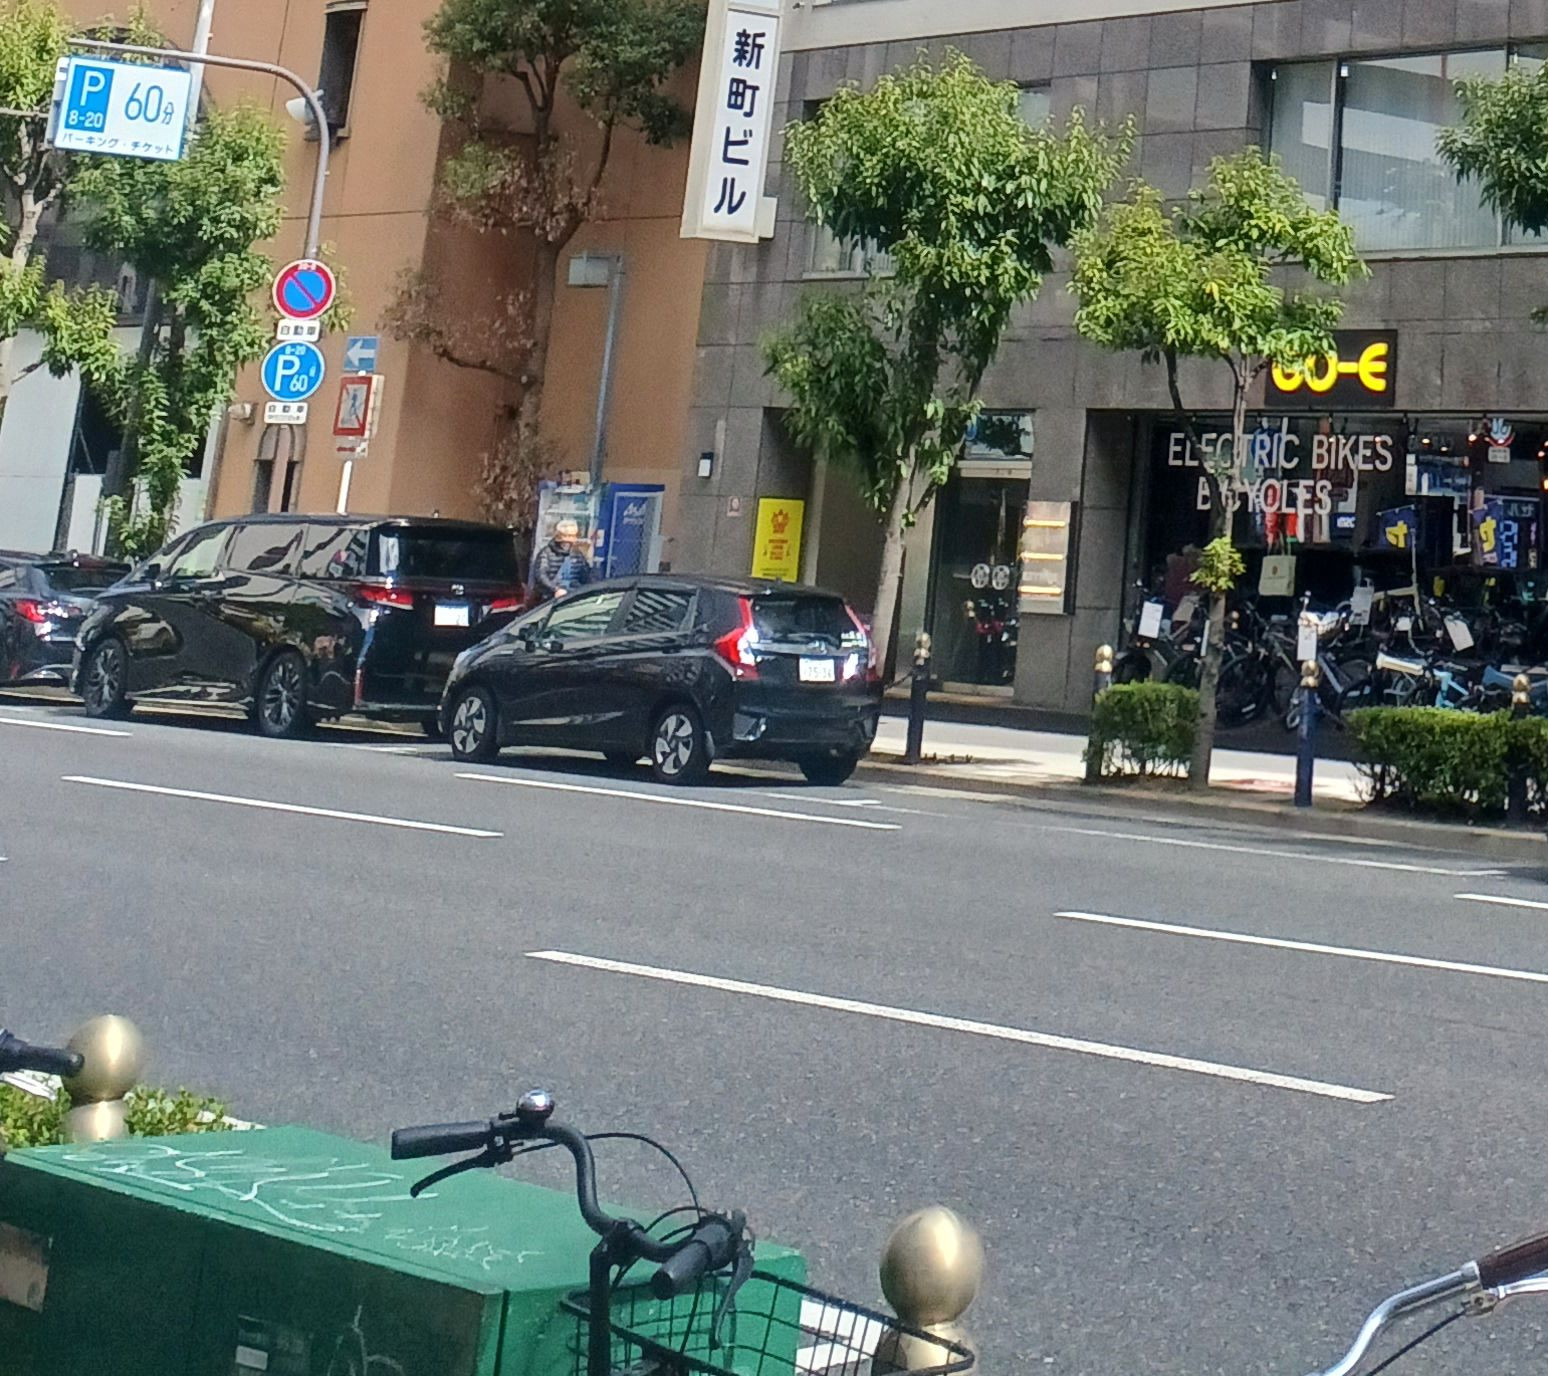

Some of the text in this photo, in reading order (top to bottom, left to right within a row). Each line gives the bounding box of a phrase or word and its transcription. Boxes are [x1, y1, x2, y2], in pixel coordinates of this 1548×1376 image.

[80, 70, 106, 106] P
[68, 109, 104, 128] 8-20
[713, 28, 766, 216] 新町ビル
[274, 354, 301, 392] P
[1311, 434, 1393, 471] BIKES
